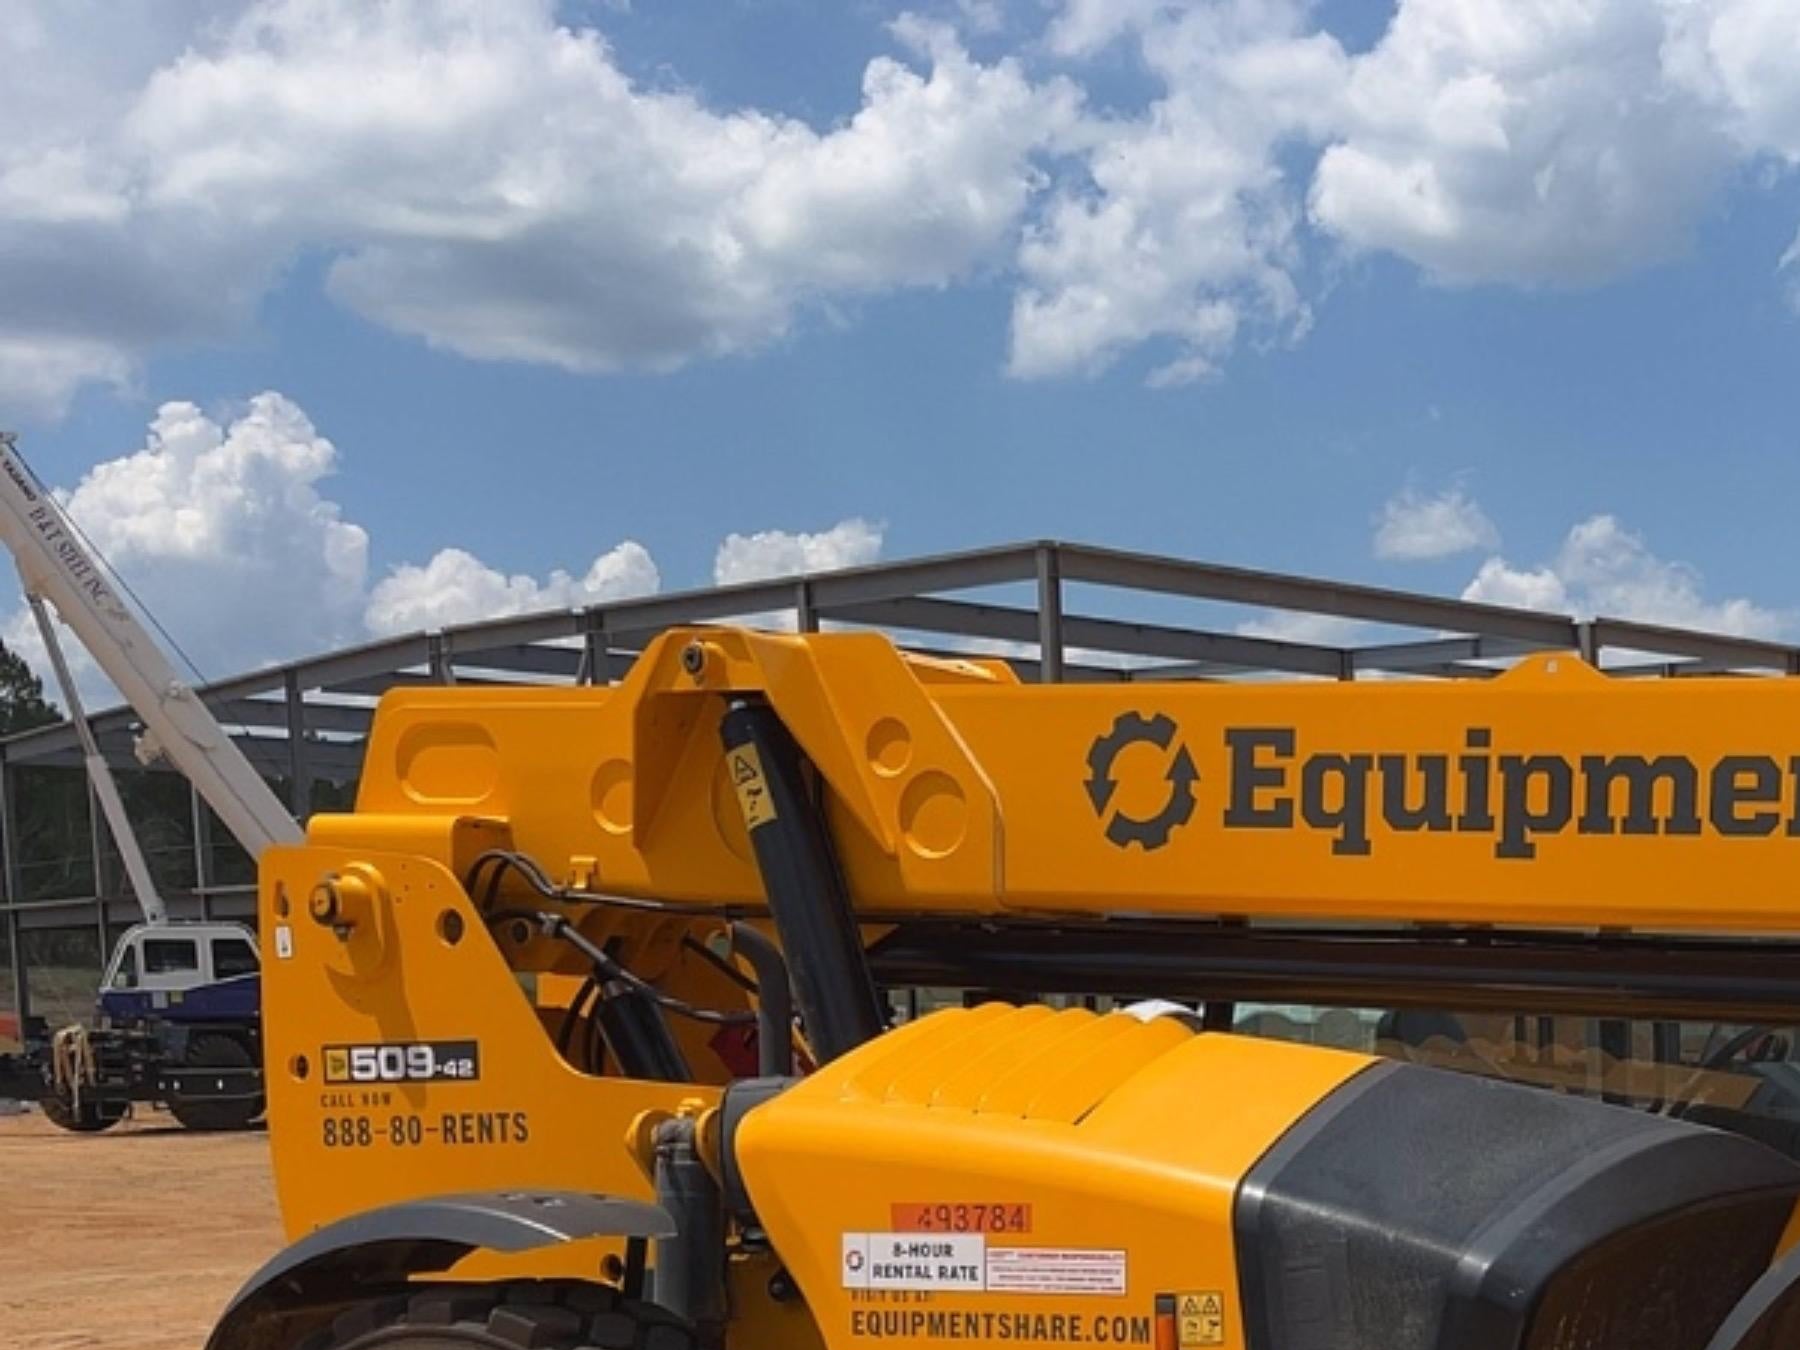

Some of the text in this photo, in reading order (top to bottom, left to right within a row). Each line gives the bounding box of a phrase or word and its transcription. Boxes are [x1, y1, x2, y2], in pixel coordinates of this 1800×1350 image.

[323, 1112, 529, 1147] 888-80-RENTS
[917, 1204, 1025, 1233] 493784
[893, 1242, 955, 1258] 8-HOUR
[872, 1264, 979, 1281] RENTAL RATE
[851, 1310, 1151, 1343] EQUIPMENTSHARE.COM
